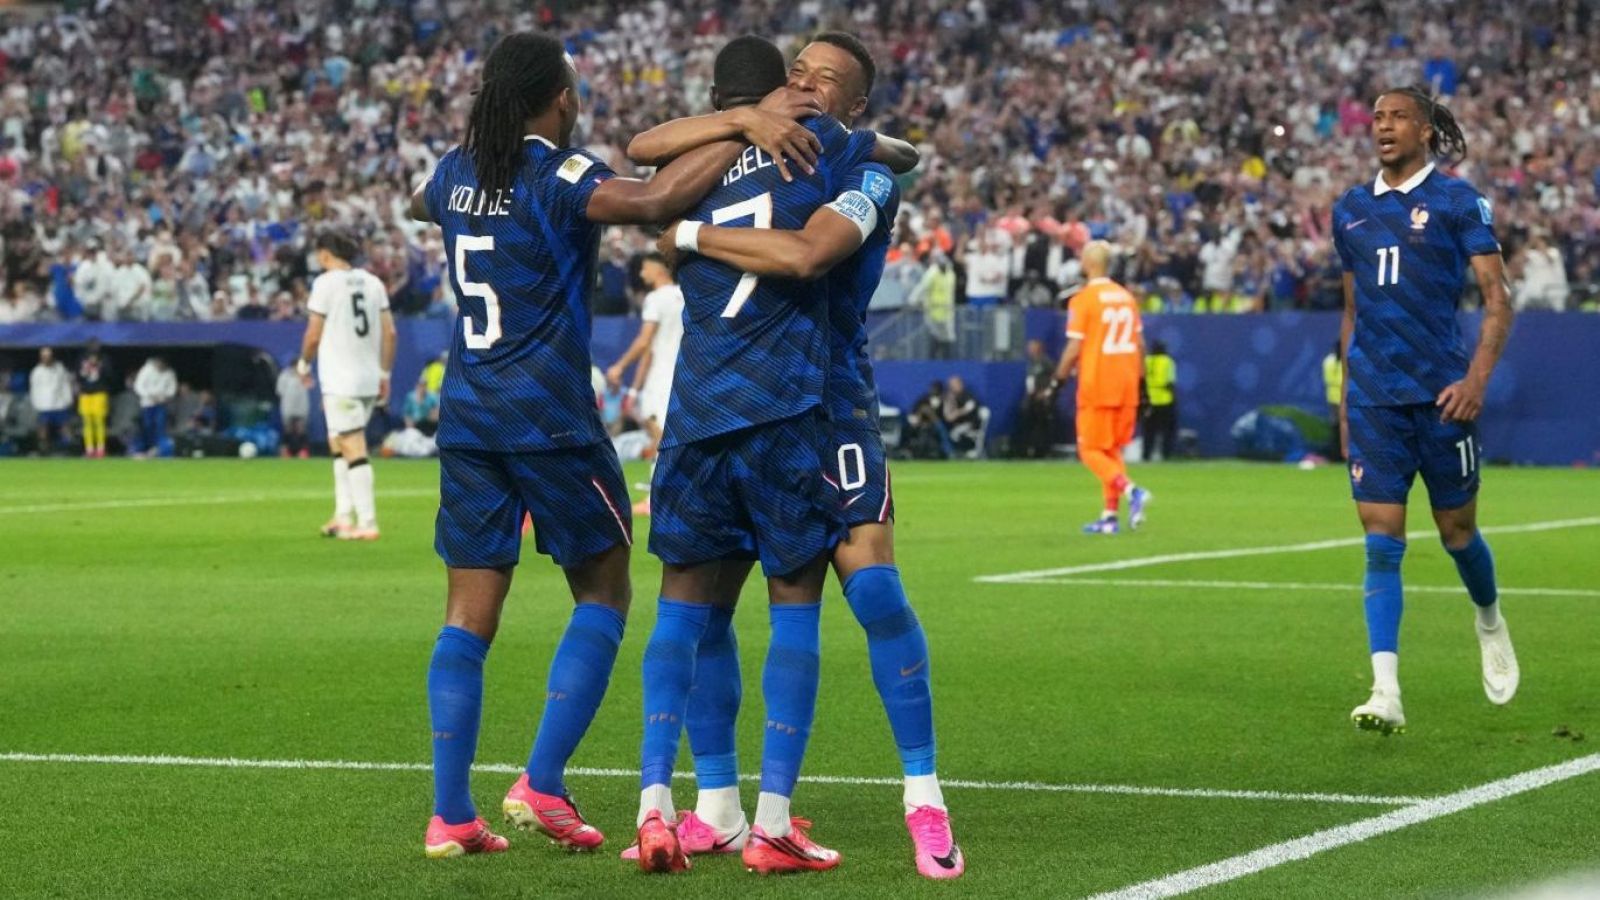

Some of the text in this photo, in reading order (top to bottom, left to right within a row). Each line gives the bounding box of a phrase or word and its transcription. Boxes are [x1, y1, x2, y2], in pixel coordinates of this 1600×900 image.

[723, 145, 787, 186] BEL
[712, 193, 771, 317] 7
[1376, 246, 1399, 286] 11
[351, 292, 369, 337] 5
[456, 236, 501, 348] 5
[1102, 307, 1135, 353] 22
[1456, 435, 1475, 477] 11
